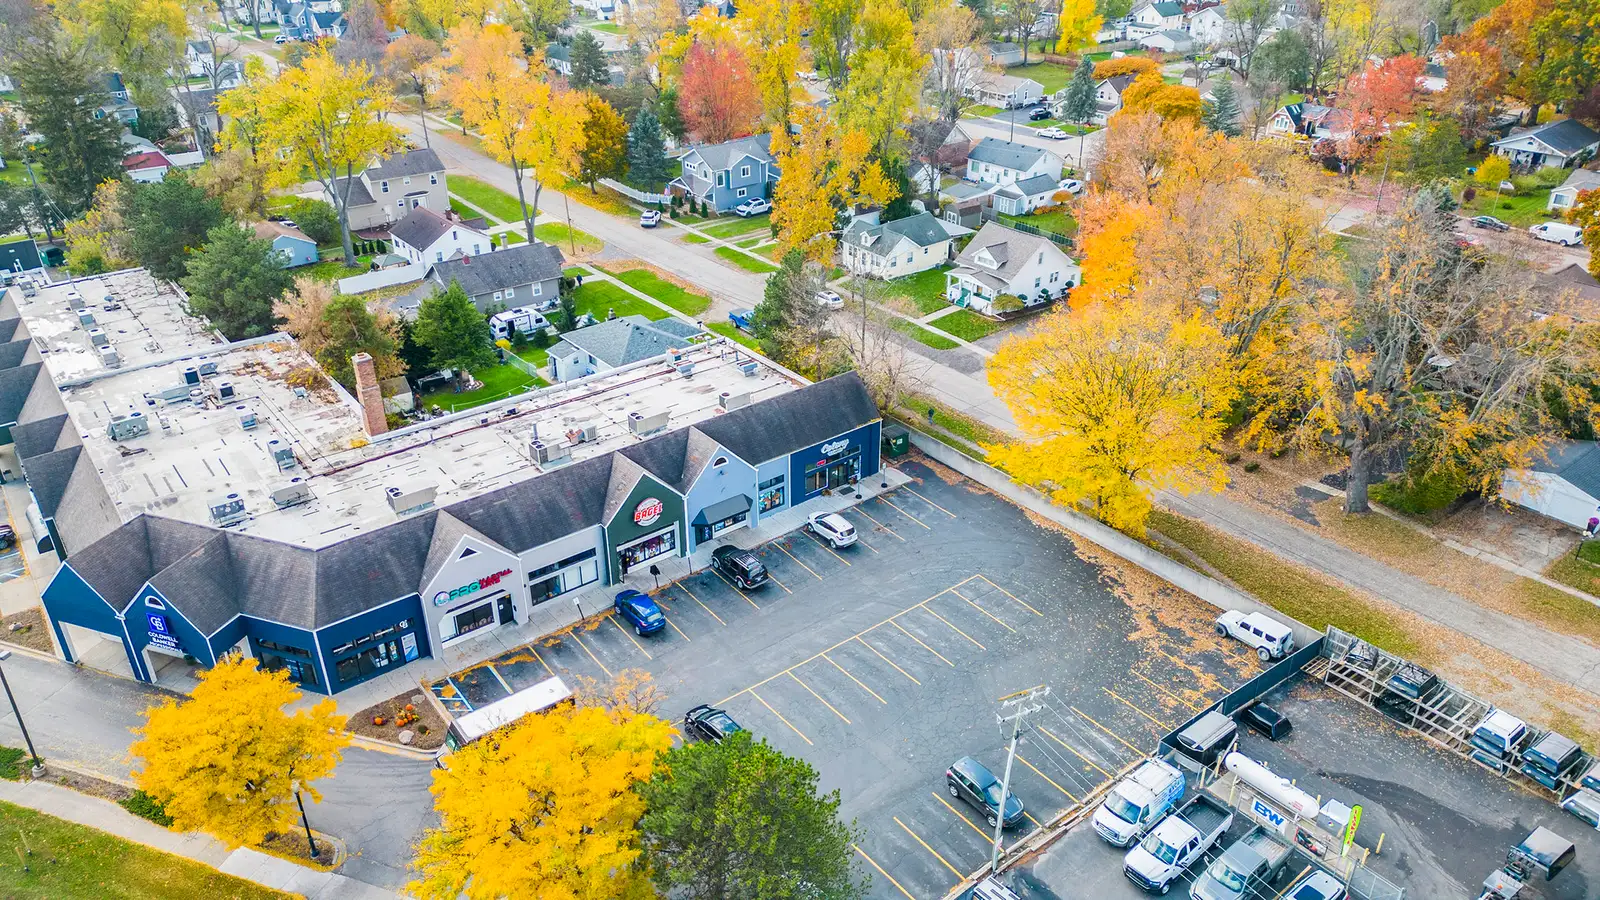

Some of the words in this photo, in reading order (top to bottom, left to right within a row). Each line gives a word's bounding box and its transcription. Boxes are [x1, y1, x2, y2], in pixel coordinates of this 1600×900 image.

[636, 504, 662, 521] BAGEL
[449, 581, 480, 600] PRO
[148, 631, 178, 643] COLDWELL
[152, 637, 176, 648] BANKER
